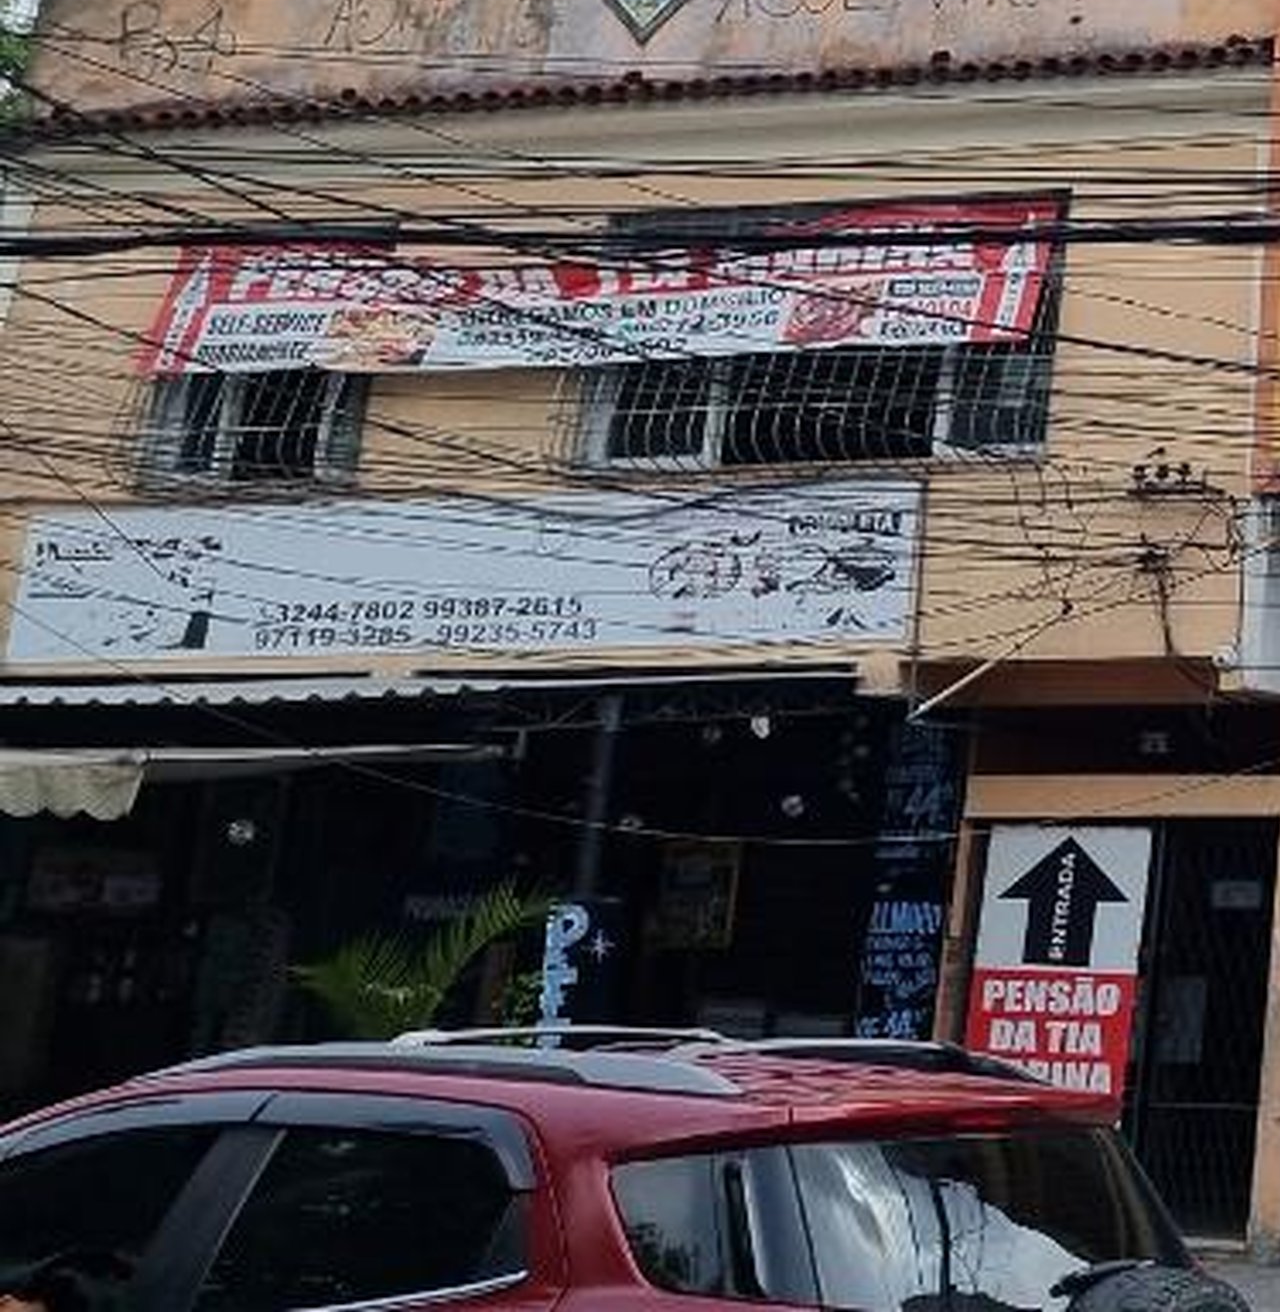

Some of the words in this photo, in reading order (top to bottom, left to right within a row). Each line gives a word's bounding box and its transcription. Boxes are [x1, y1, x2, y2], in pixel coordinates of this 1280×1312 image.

[1048, 851, 1078, 961] ENTRADA
[982, 975, 1123, 1016] PENSÃO
[989, 1019, 1037, 1053] DA
[1045, 1020, 1102, 1055] TIA
